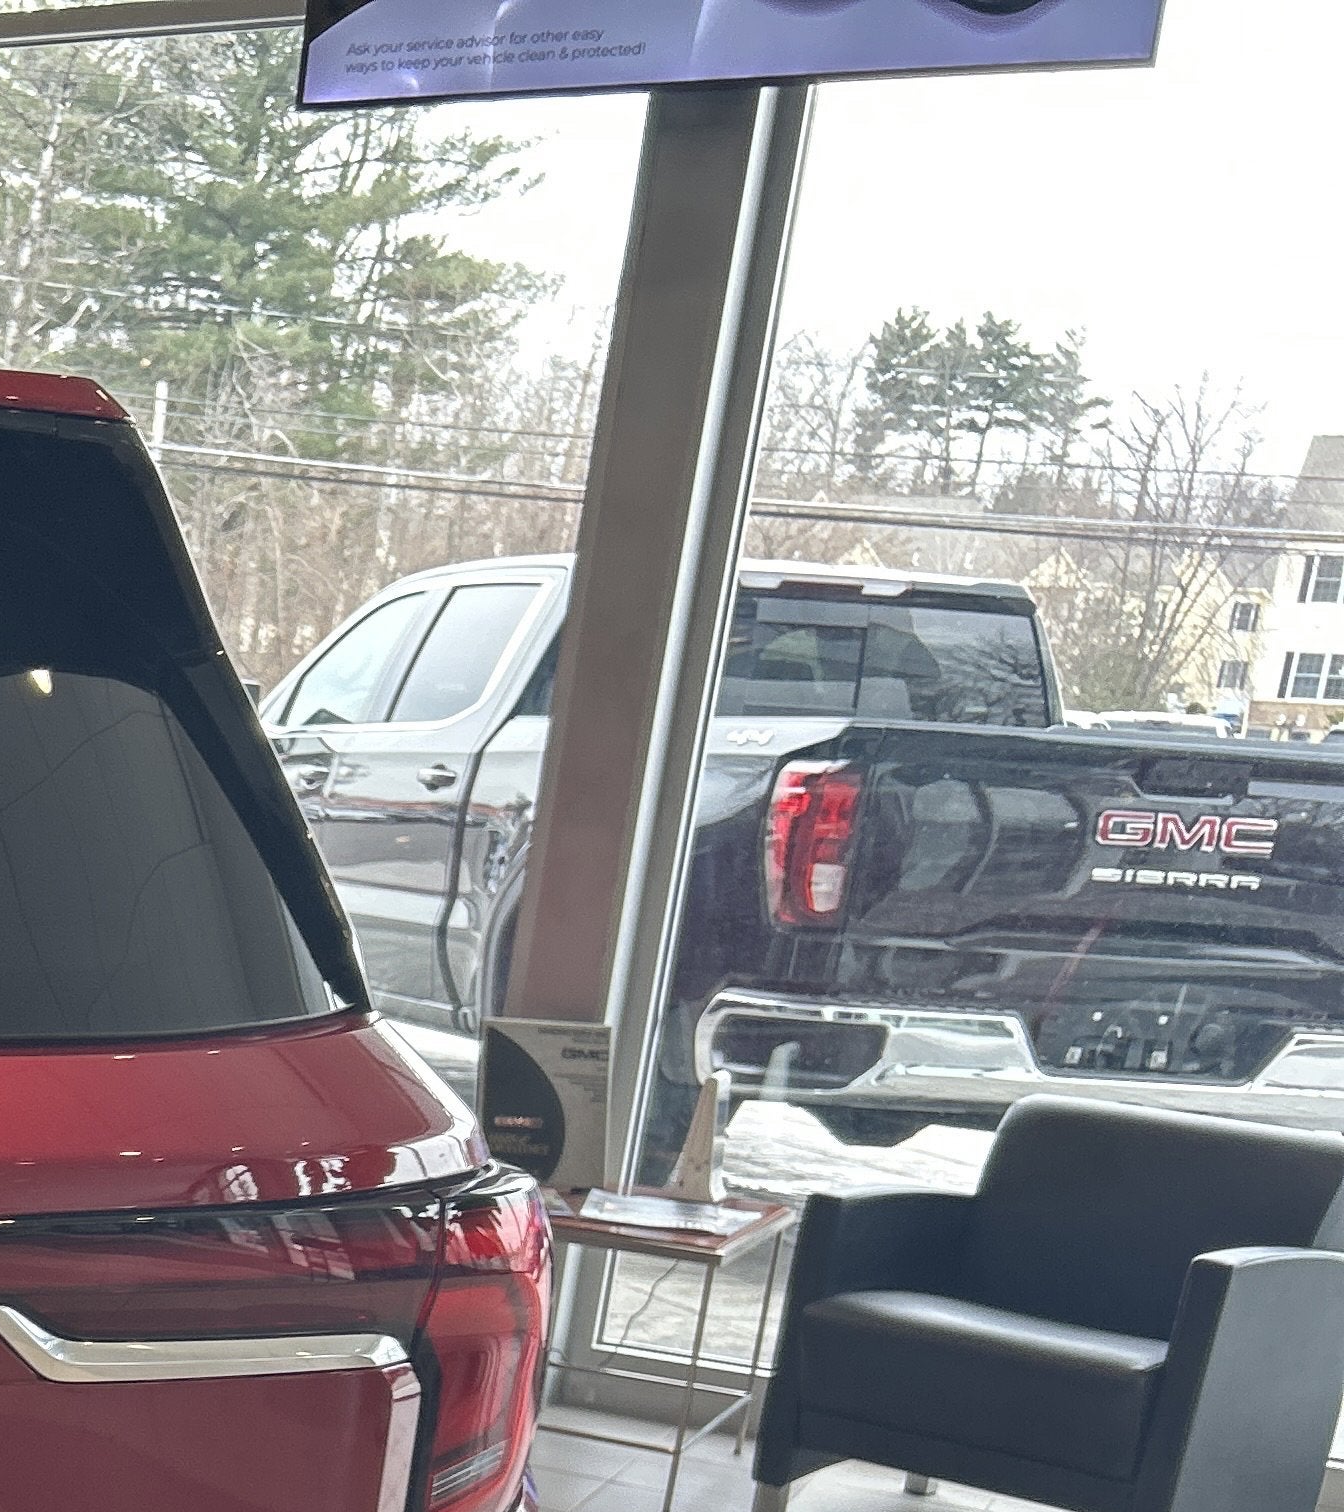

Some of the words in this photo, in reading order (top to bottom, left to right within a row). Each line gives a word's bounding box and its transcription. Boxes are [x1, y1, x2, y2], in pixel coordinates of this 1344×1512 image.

[346, 43, 370, 56] Ask
[370, 42, 404, 57] your
[406, 37, 454, 52] service
[456, 34, 506, 50] advisor
[509, 31, 528, 45] for
[530, 29, 569, 44] other
[572, 29, 605, 42] easy
[345, 60, 378, 75] ways
[381, 59, 395, 71] to
[398, 57, 430, 71] keep
[433, 54, 463, 70] your
[466, 51, 516, 66] vehicle
[518, 49, 556, 63] clean
[558, 48, 569, 60] &
[571, 42, 647, 61] protected!
[1096, 809, 1279, 859] GMC
[1091, 866, 1263, 891] SIERRA
